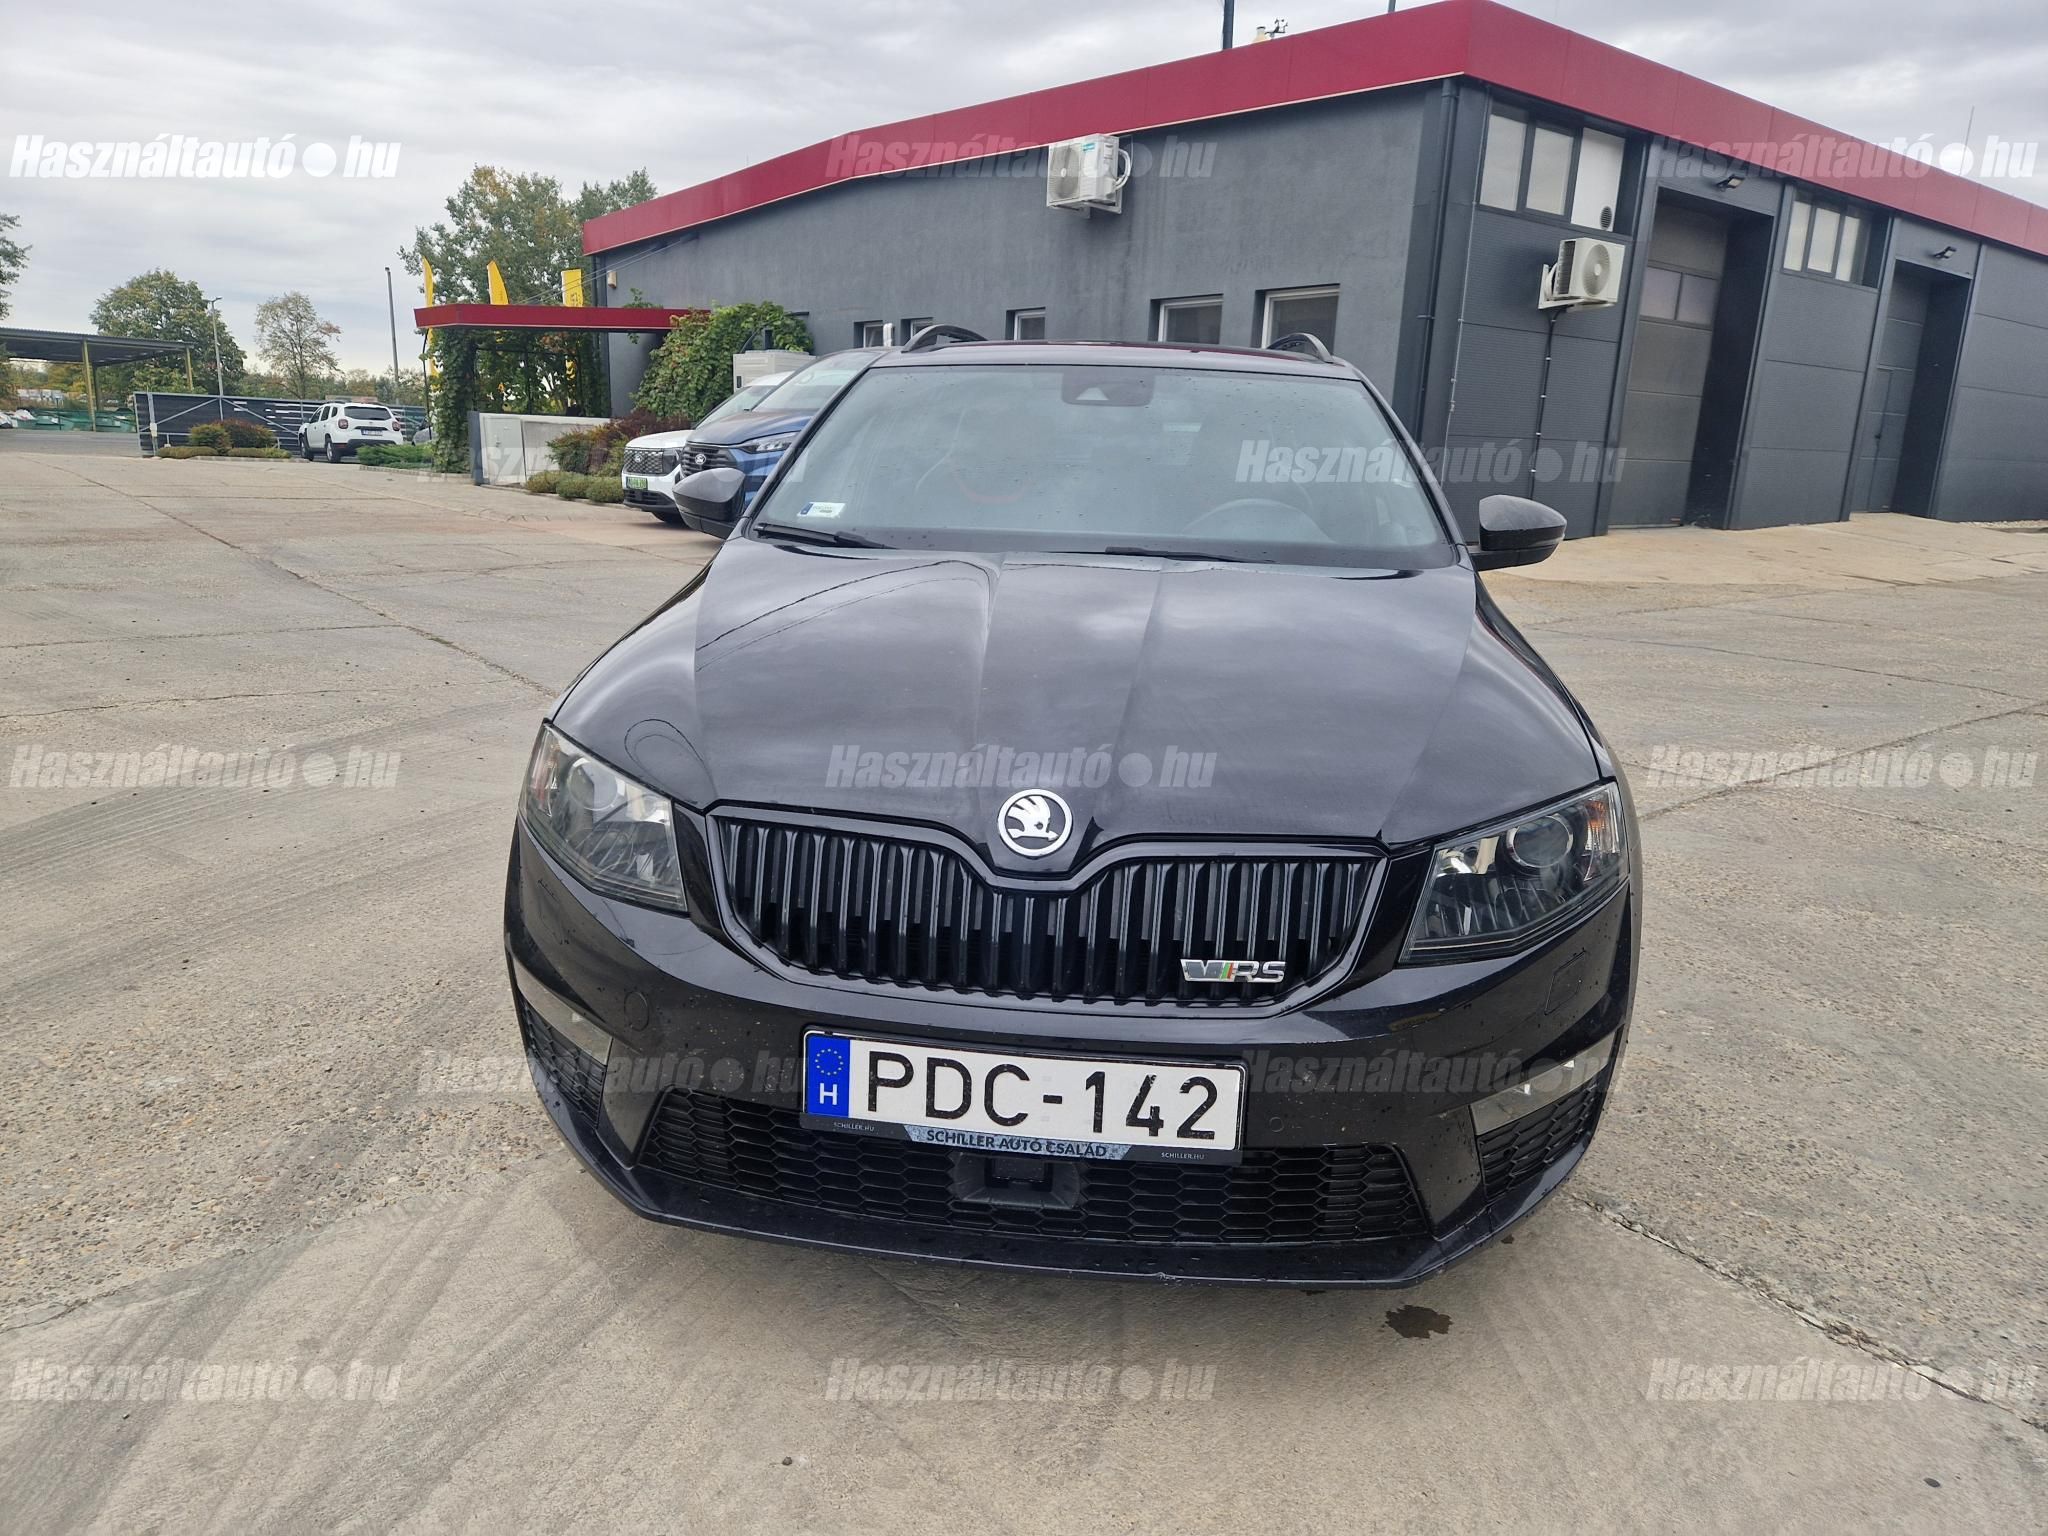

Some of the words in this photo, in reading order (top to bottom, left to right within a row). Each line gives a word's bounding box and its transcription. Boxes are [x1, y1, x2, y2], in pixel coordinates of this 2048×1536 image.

[819, 1082, 838, 1106] H
[867, 1050, 1218, 1140] PDC-142
[926, 1129, 995, 1149] SCHILLER
[1001, 1136, 1042, 1153] AUTÓ
[1045, 1142, 1107, 1157] CSALÁD
[1161, 1151, 1205, 1160] SCHILLER.HU
